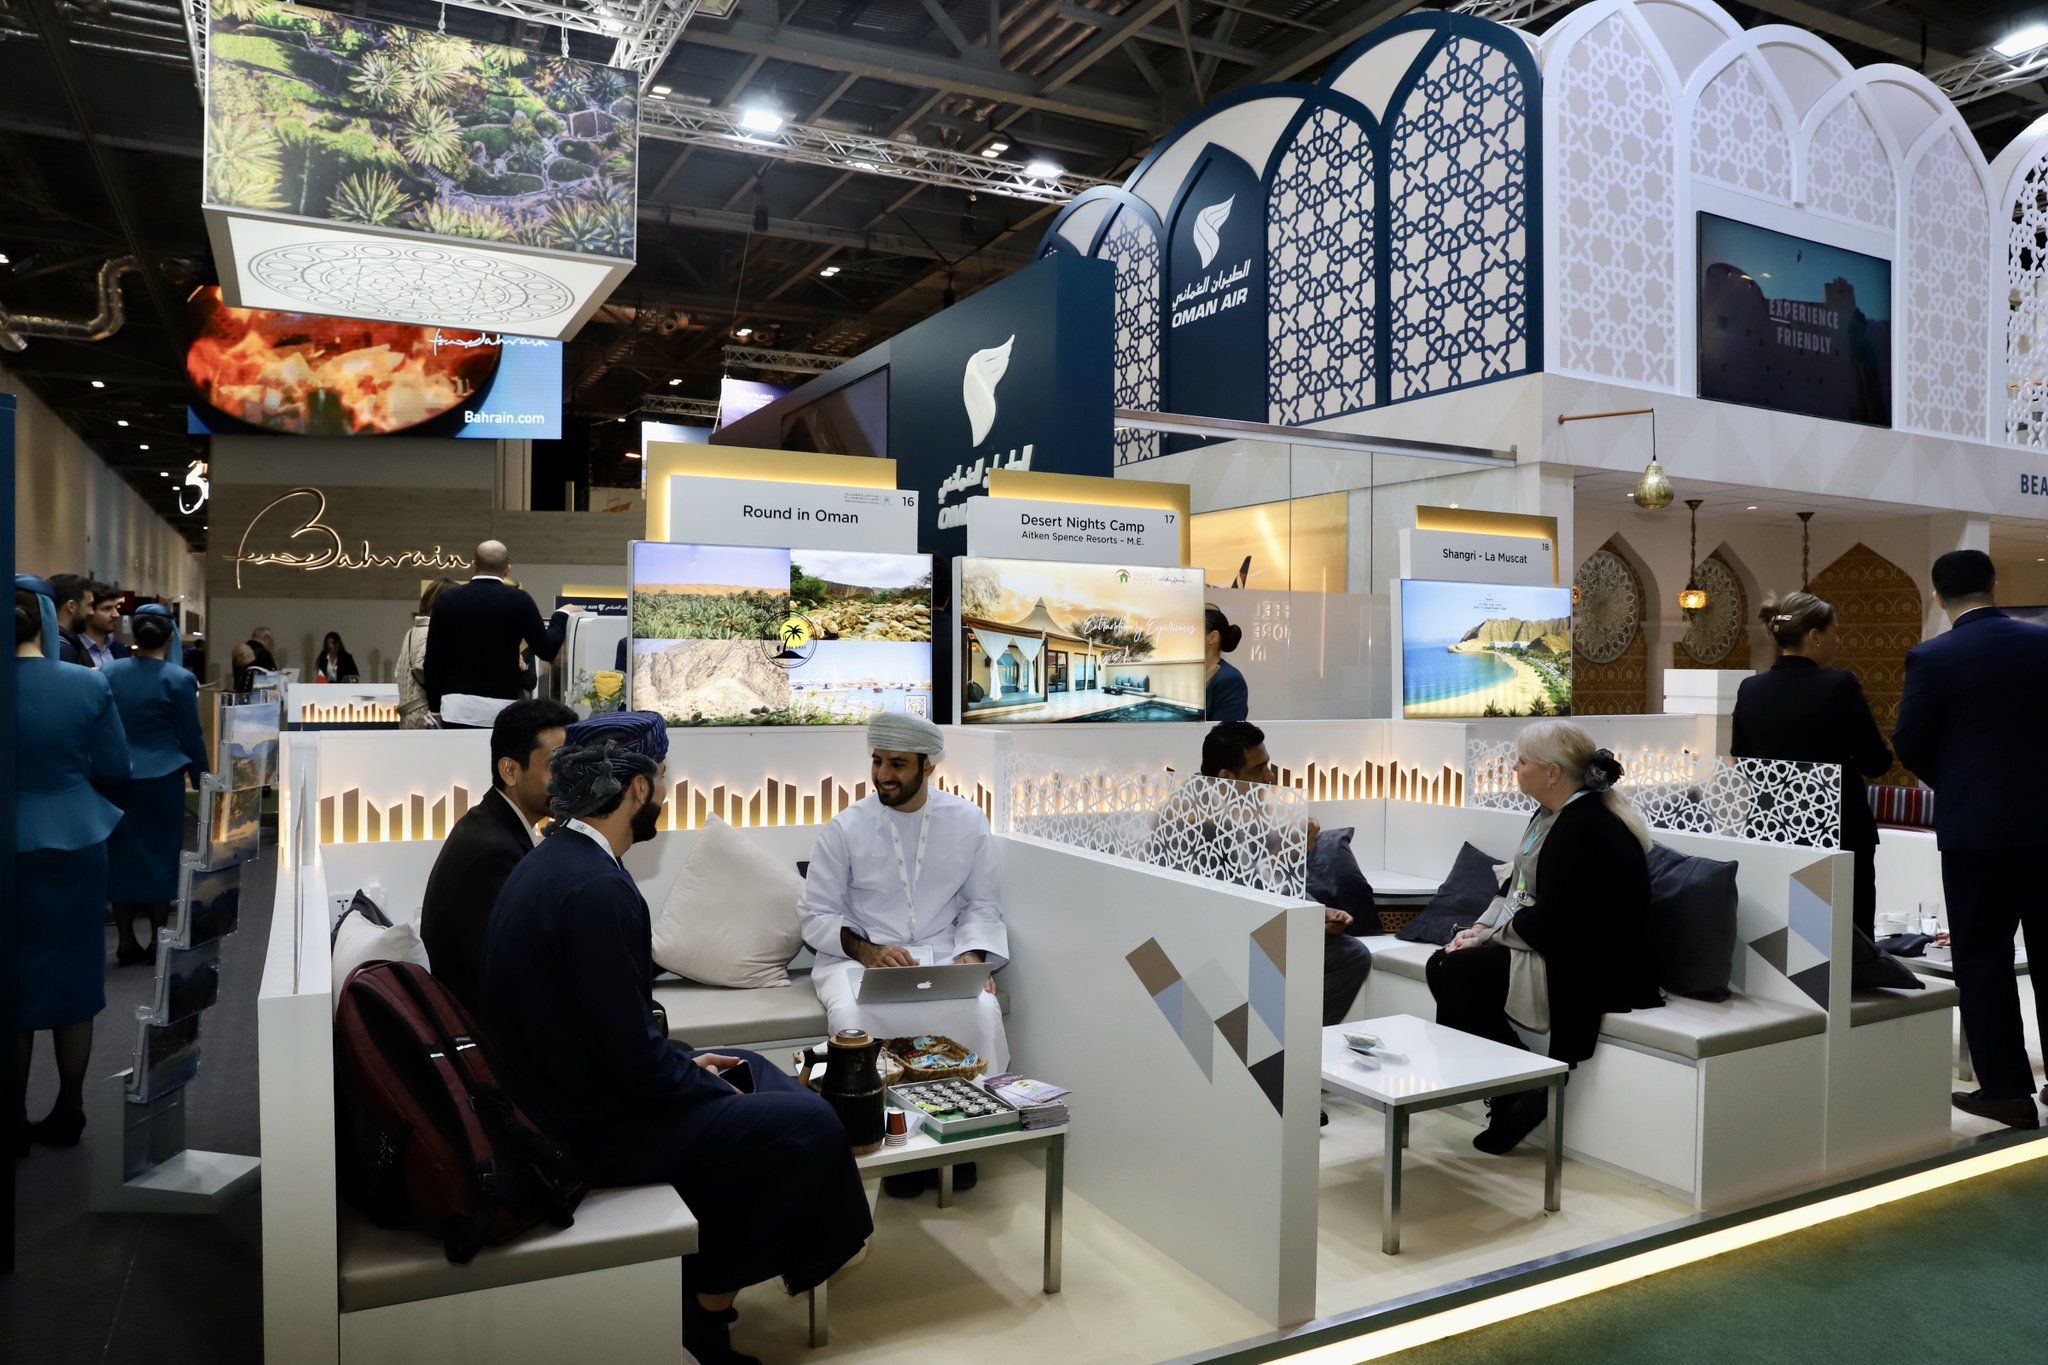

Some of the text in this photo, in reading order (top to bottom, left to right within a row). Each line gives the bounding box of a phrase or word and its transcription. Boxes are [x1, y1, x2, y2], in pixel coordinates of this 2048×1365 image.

[1171, 287, 1249, 328] OMAN AIR
[1769, 297, 1840, 330] EXPERIENCE
[1776, 326, 1832, 354] FRIENDLY
[464, 410, 545, 424] Bahrain.com
[902, 496, 914, 507] 16
[743, 505, 859, 524] Round in Oman
[1164, 514, 1175, 524] 17
[1021, 513, 1145, 534] Desert Nights Camp
[1021, 530, 1050, 541] Aitken
[1052, 532, 1084, 543] Spence
[1086, 535, 1118, 545] Resorts
[1127, 537, 1145, 546] M.E.
[1542, 542, 1550, 552] 18
[1442, 548, 1477, 562] Shangri
[1484, 551, 1496, 562] La
[1498, 552, 1528, 564] Muscat
